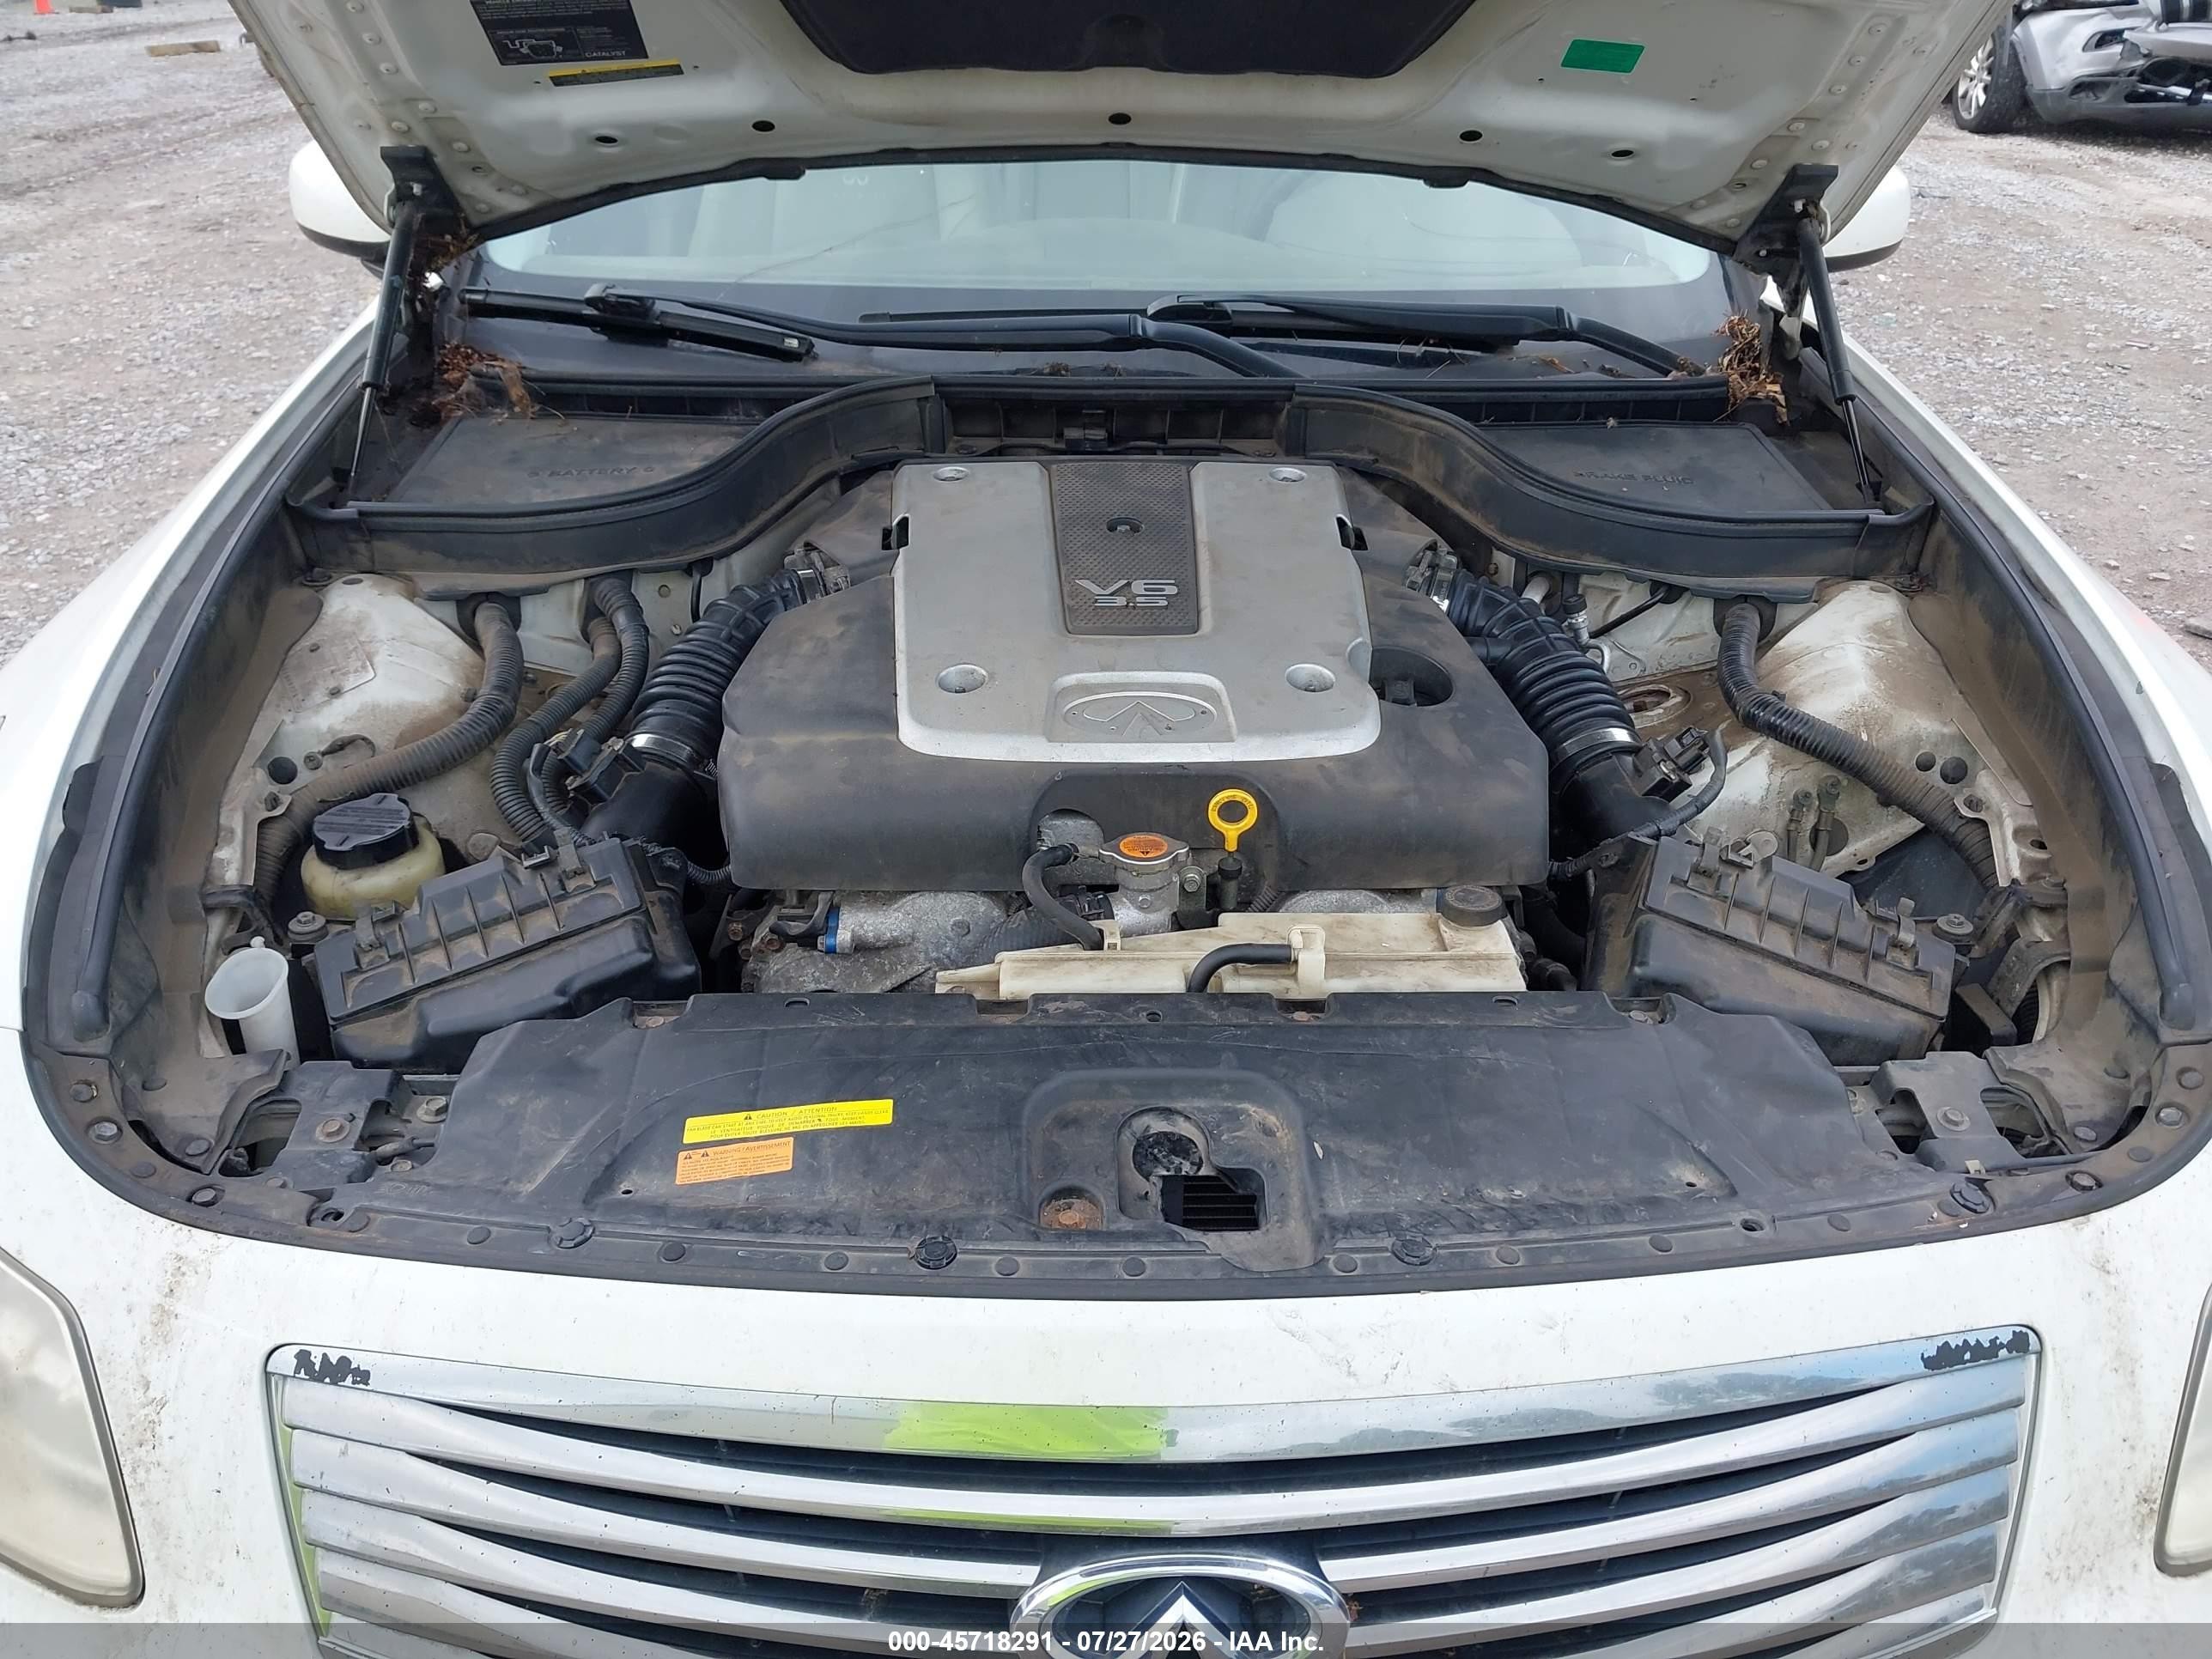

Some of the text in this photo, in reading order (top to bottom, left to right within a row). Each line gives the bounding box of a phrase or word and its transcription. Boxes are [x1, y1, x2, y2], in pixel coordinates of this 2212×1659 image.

[1074, 579, 1179, 596] V6
[1093, 596, 1169, 608] 3.5
[713, 1146, 741, 1156] WARNING
